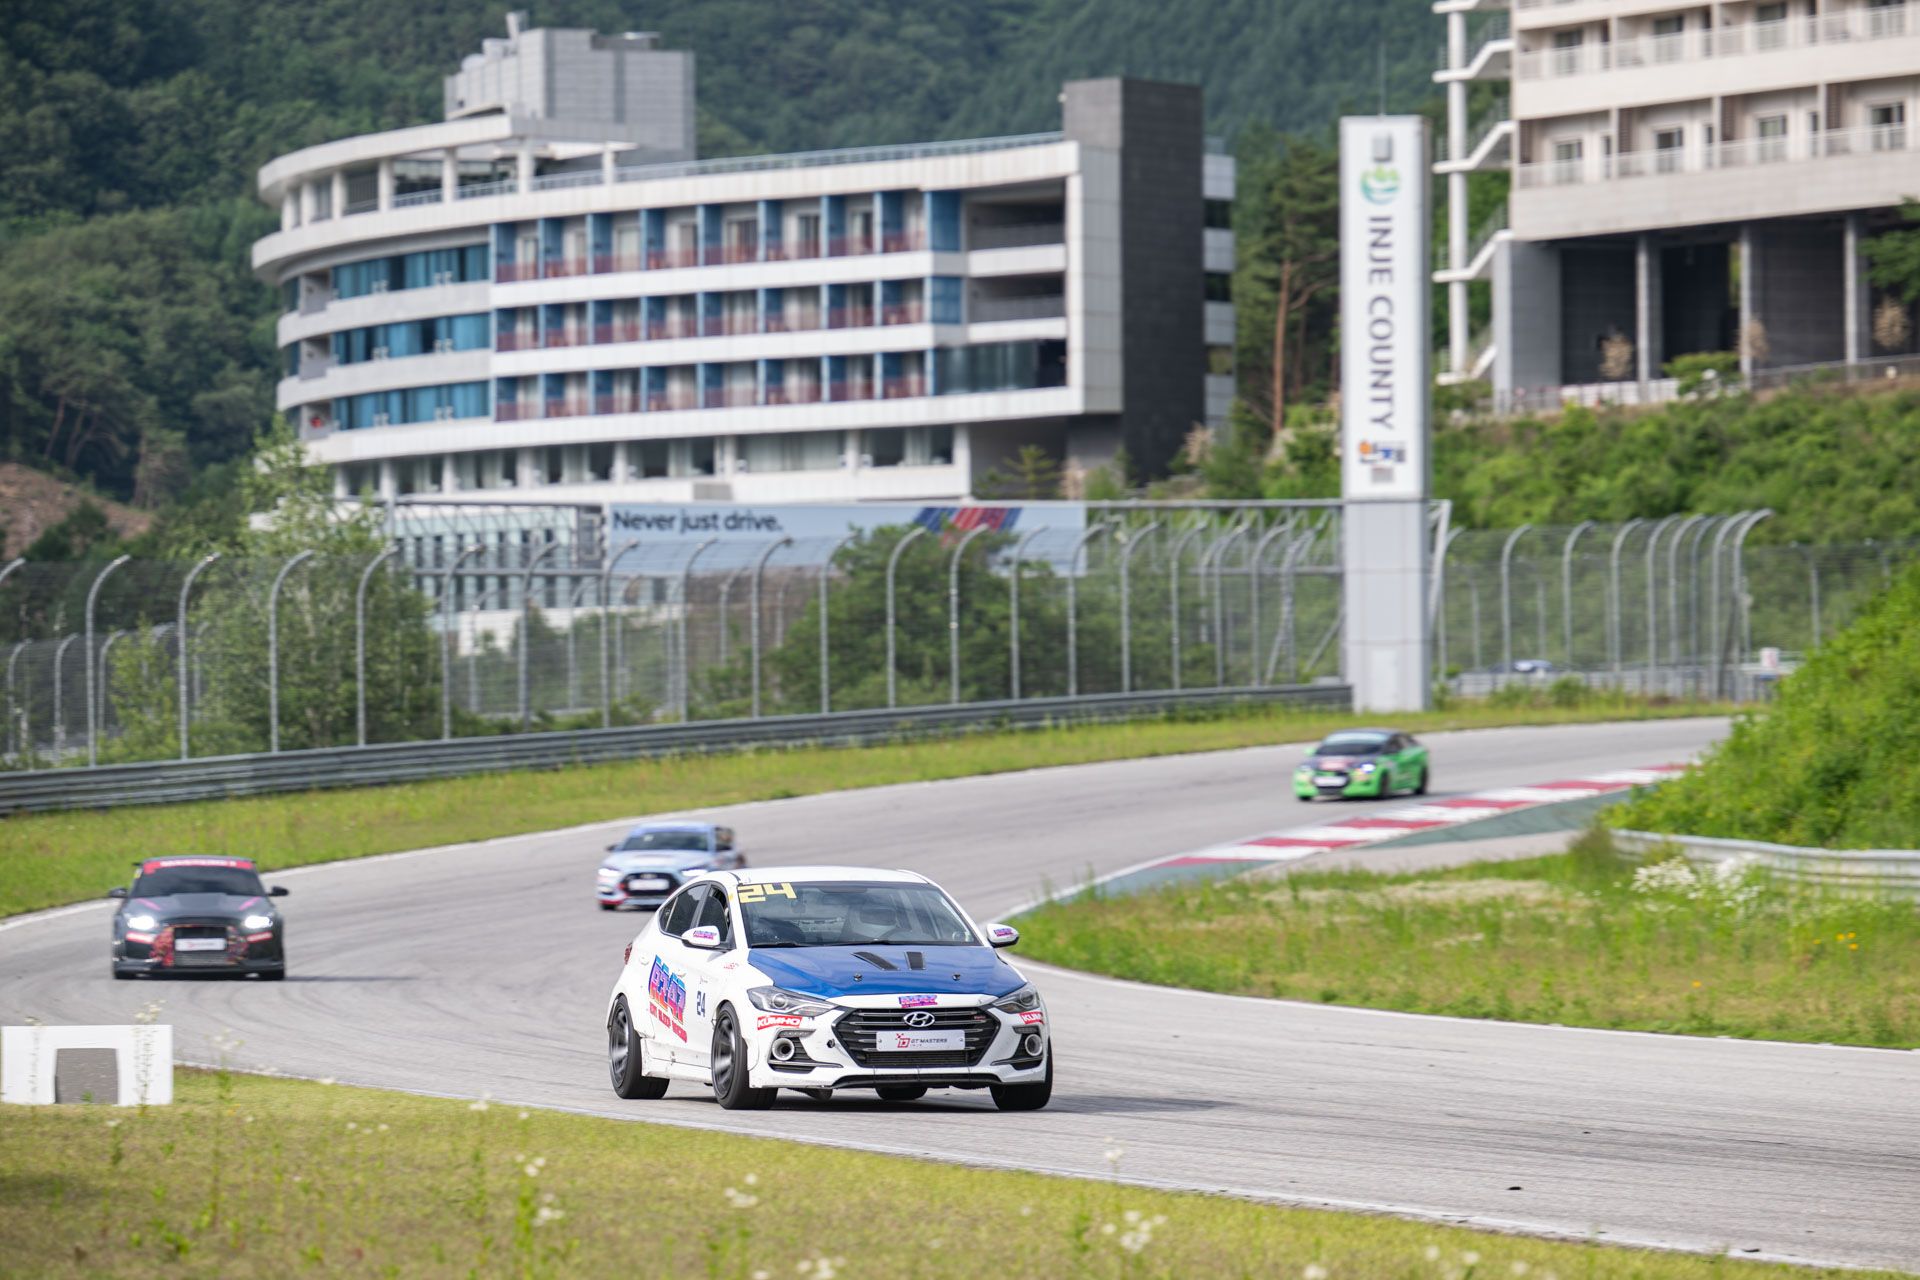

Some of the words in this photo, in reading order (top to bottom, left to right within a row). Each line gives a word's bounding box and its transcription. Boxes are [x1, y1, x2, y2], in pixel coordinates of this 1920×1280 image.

[1368, 216, 1394, 285] INJE
[1368, 295, 1394, 429] COUNTY
[613, 511, 676, 530] Never
[679, 509, 718, 534] just
[724, 510, 783, 531] drive.
[738, 882, 797, 904] 24
[696, 990, 706, 1018] 24
